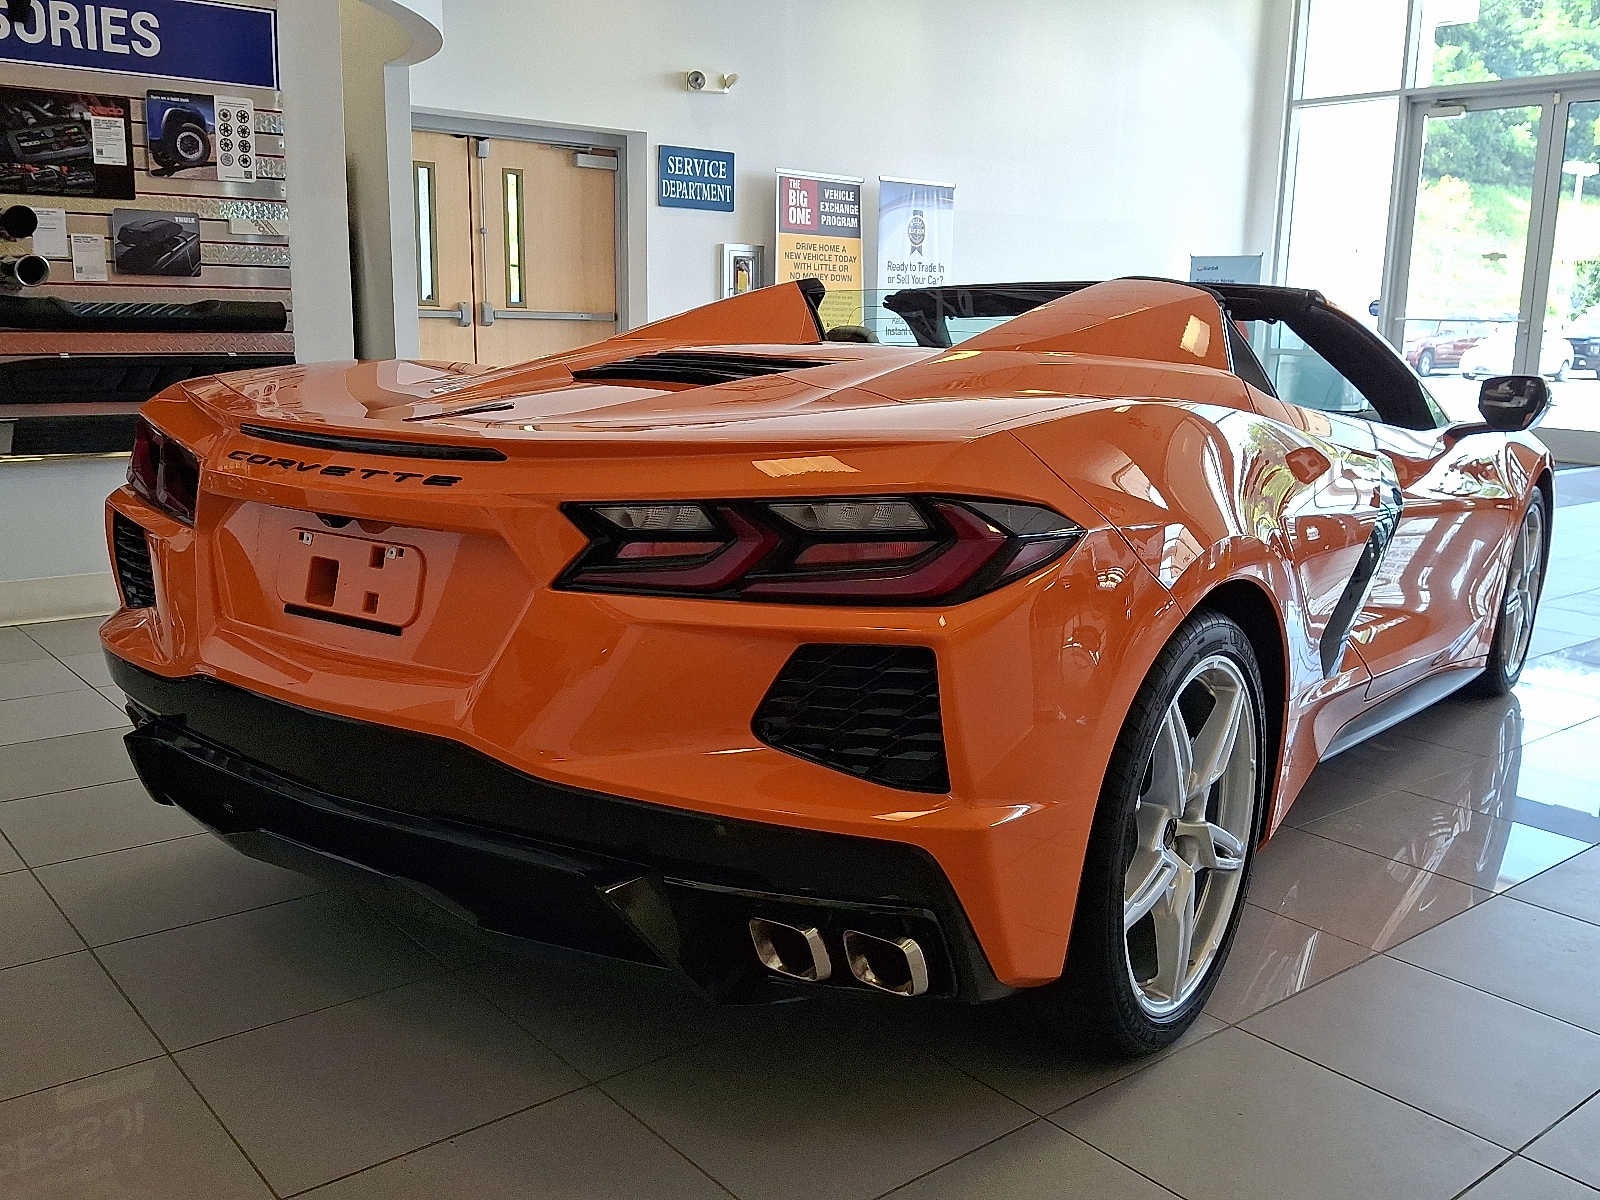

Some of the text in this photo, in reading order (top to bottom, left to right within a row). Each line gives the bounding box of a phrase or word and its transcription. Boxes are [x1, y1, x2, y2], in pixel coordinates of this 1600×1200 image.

[667, 156, 727, 179] SERVICE
[788, 178, 801, 189] THE
[662, 179, 732, 203] DEPARTMENT
[824, 188, 855, 201] VEHICLE
[788, 189, 808, 207] BIG
[820, 201, 859, 215] EXCHANGE
[788, 206, 812, 225] ONE
[821, 215, 858, 228] PROGRAM
[795, 242, 847, 253] DRIVE HOME A
[784, 251, 858, 264] NEW VEHICLE TODAY
[793, 262, 849, 273] WITH LITTLE OR
[887, 260, 945, 273] Ready to Trade In
[789, 272, 801, 280] NO
[830, 273, 853, 282] DOWN
[887, 274, 944, 285] or Sell Your Car?
[227, 450, 463, 487] CORVETTE
